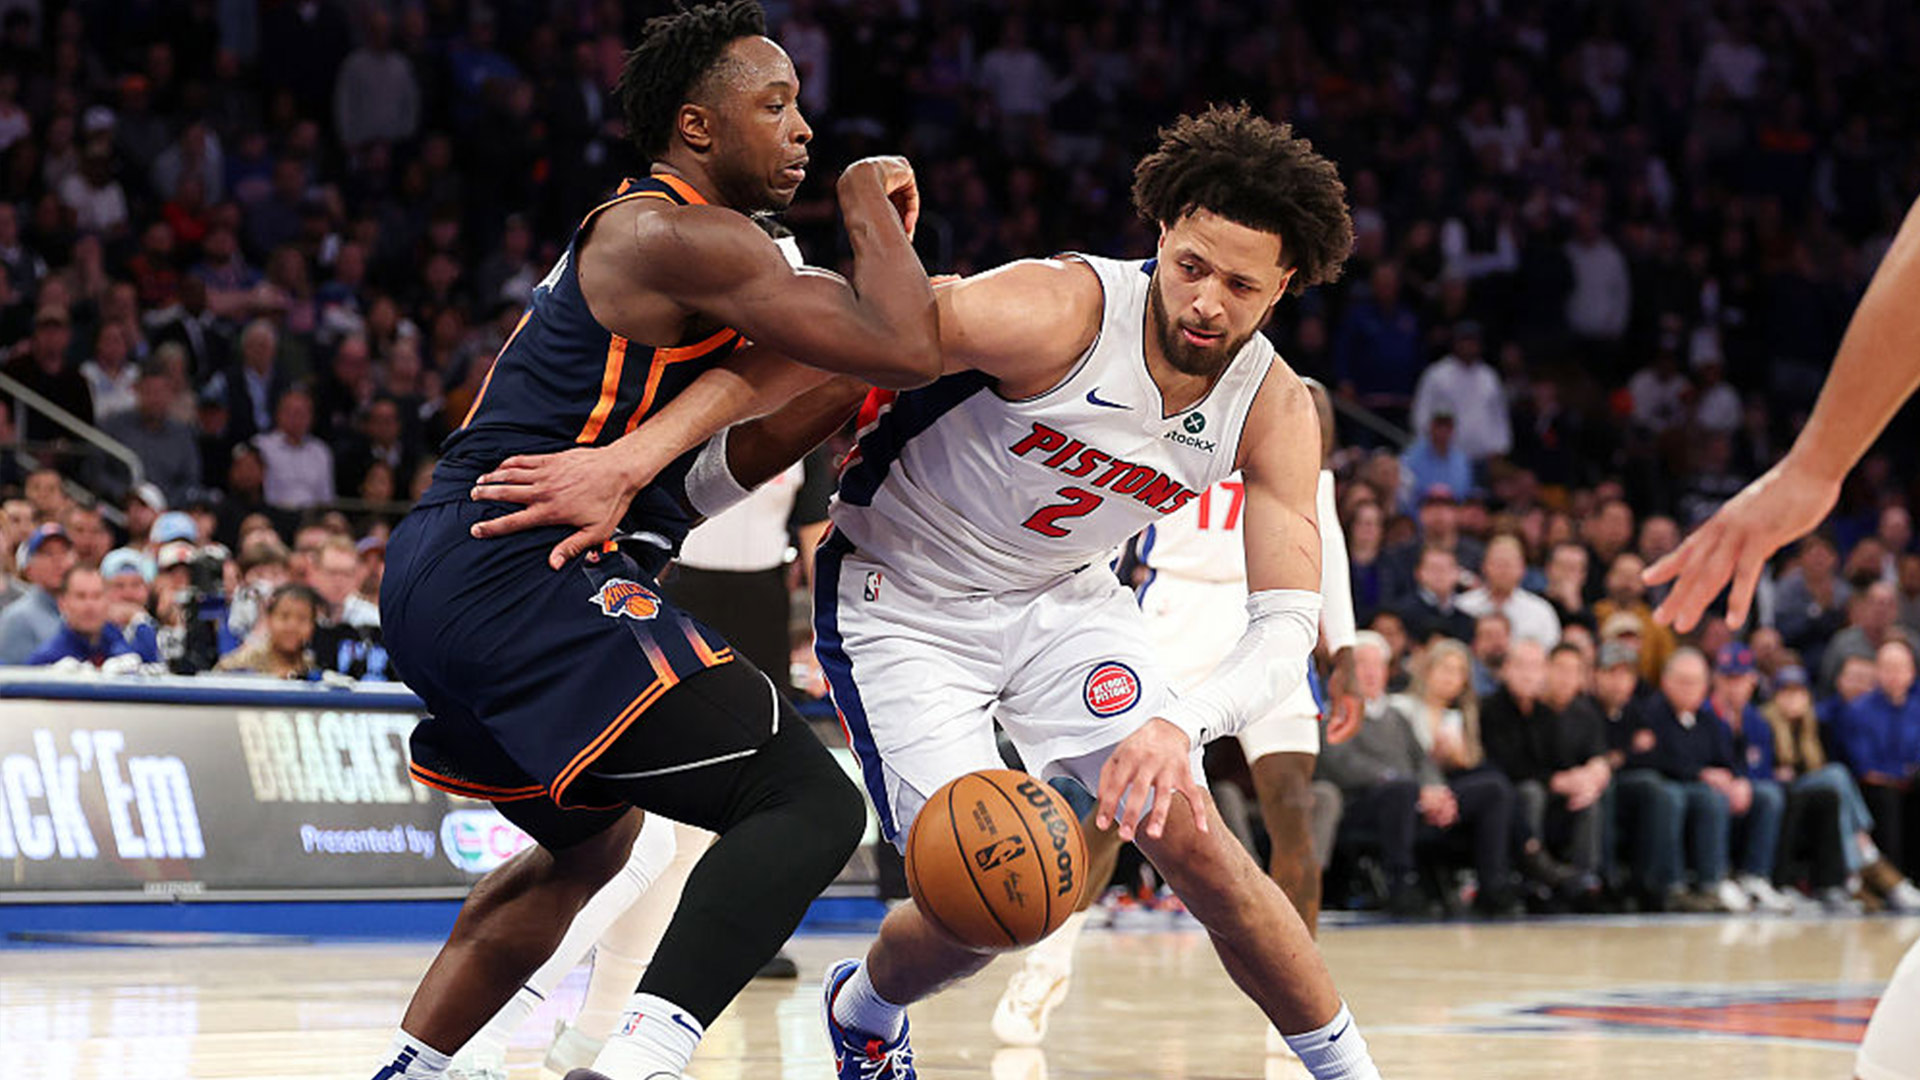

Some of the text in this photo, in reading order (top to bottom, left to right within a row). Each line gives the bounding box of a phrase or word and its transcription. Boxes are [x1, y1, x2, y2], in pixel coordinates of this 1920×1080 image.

[1009, 421, 1200, 515] PISTONS
[1020, 486, 1104, 538] 2
[1198, 482, 1245, 529] 17
[301, 824, 436, 859] Presented by
[1016, 780, 1074, 897] Wilson
